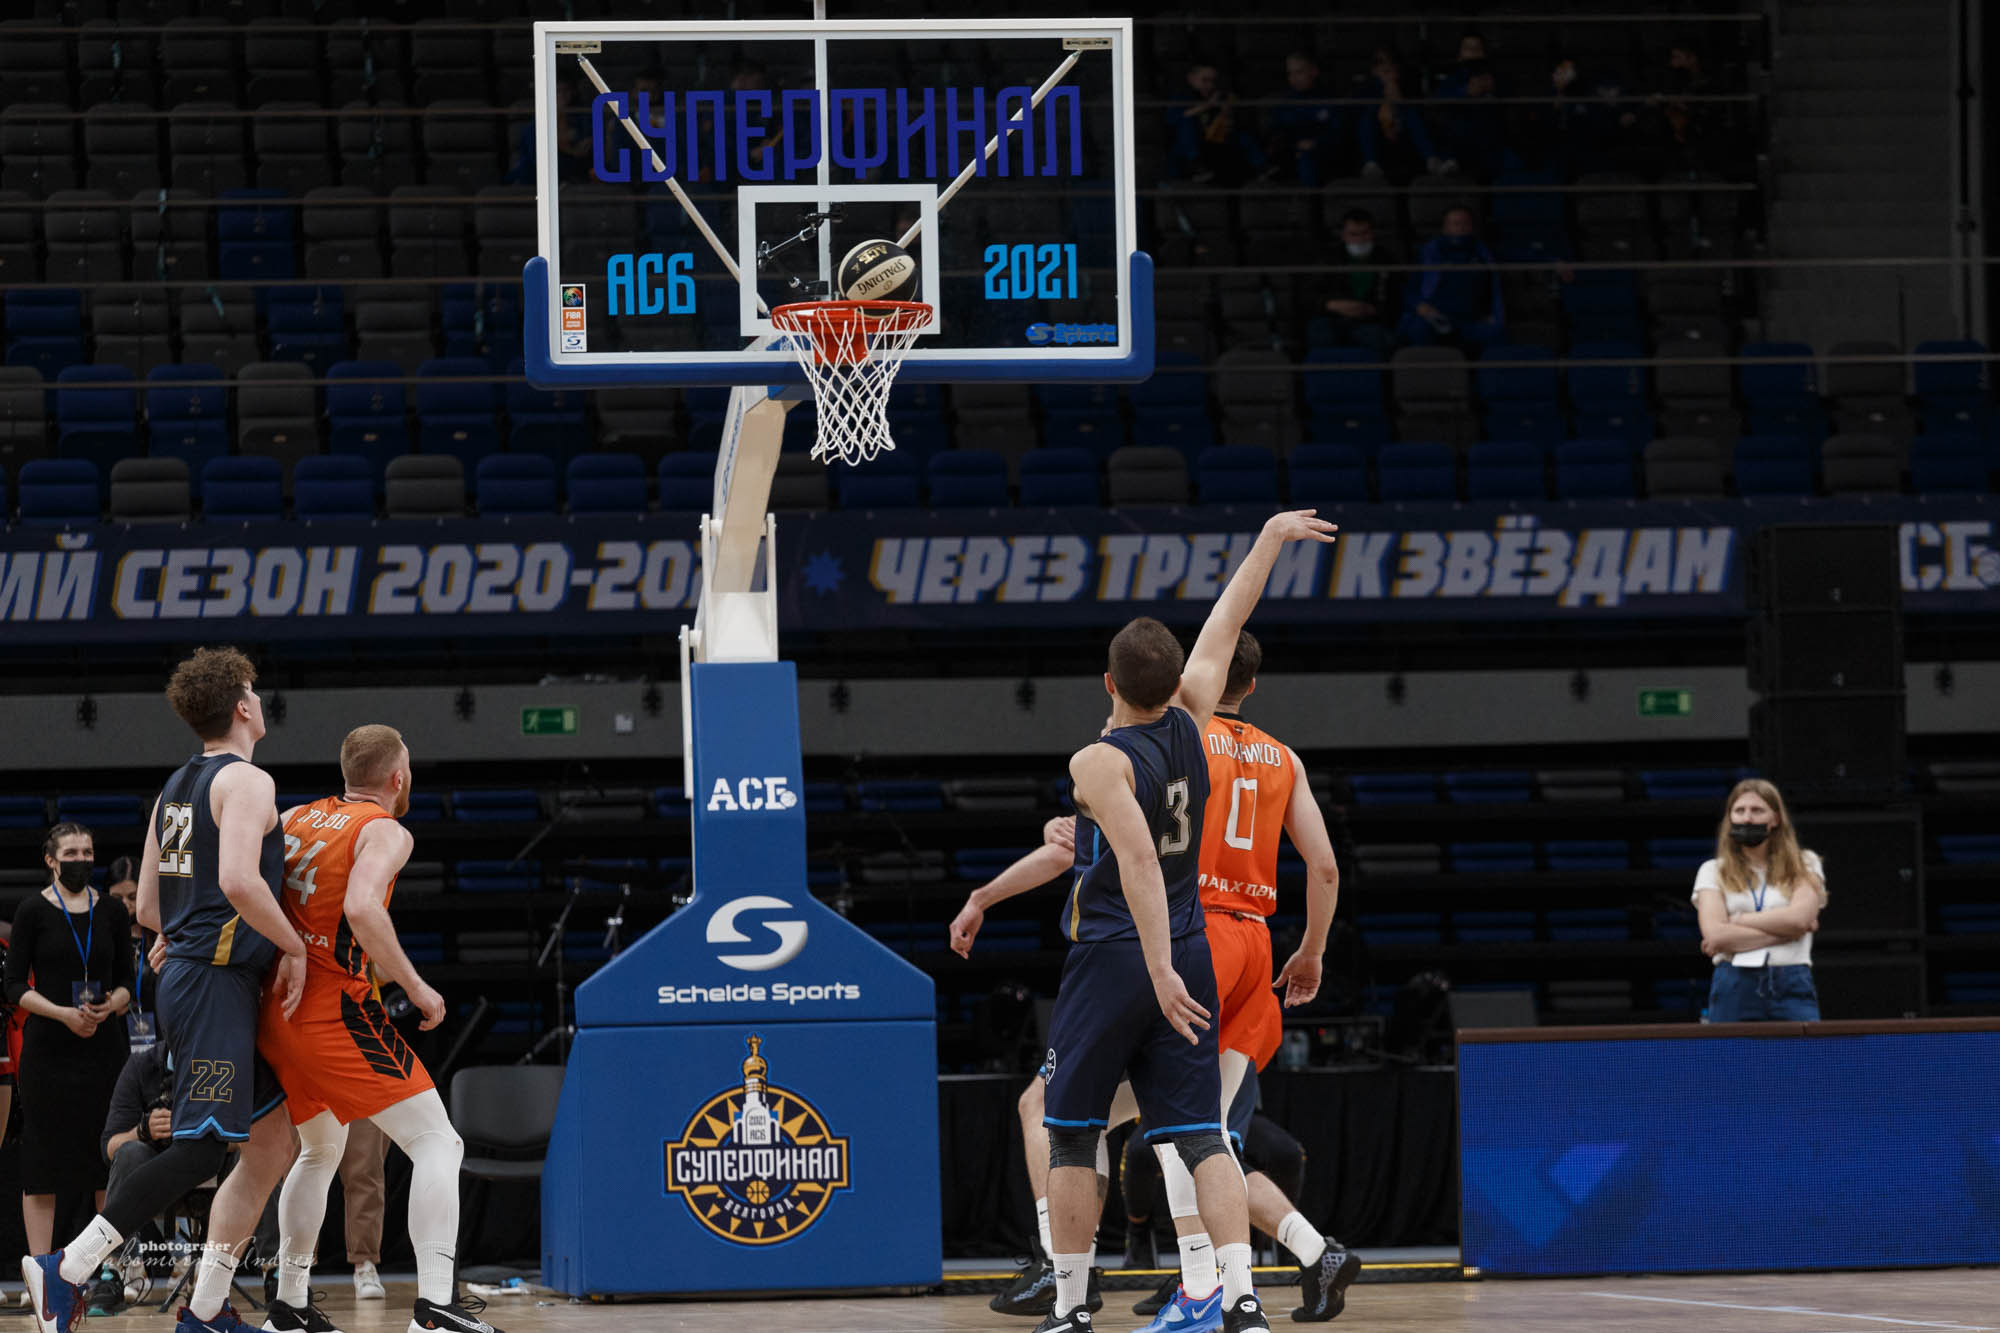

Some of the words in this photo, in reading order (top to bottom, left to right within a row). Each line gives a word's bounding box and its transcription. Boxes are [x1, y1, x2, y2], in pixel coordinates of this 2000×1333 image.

[592, 85, 1082, 182] СУПЕРФИНАЛ
[857, 258, 907, 295] SPALDING
[983, 243, 1078, 299] 2021
[112, 547, 362, 620] СЕЗОН
[368, 540, 702, 616] 2020-20
[869, 536, 1095, 603] ЧЕРЕЗ
[1329, 531, 1394, 599] К
[1395, 514, 1737, 607] ЗВЁЗДАМ
[706, 776, 797, 811] АСБ
[1158, 776, 1192, 857] 3
[1224, 777, 1258, 851] 0
[158, 802, 193, 878] 22
[658, 984, 766, 1004] Schelde
[771, 981, 860, 1005] Sports
[189, 1059, 235, 1103] 22
[749, 1115, 766, 1126] 2021
[676, 1147, 838, 1182] СУПЕРФИНАЛ
[724, 1197, 795, 1219] БЕЛГОРОД
